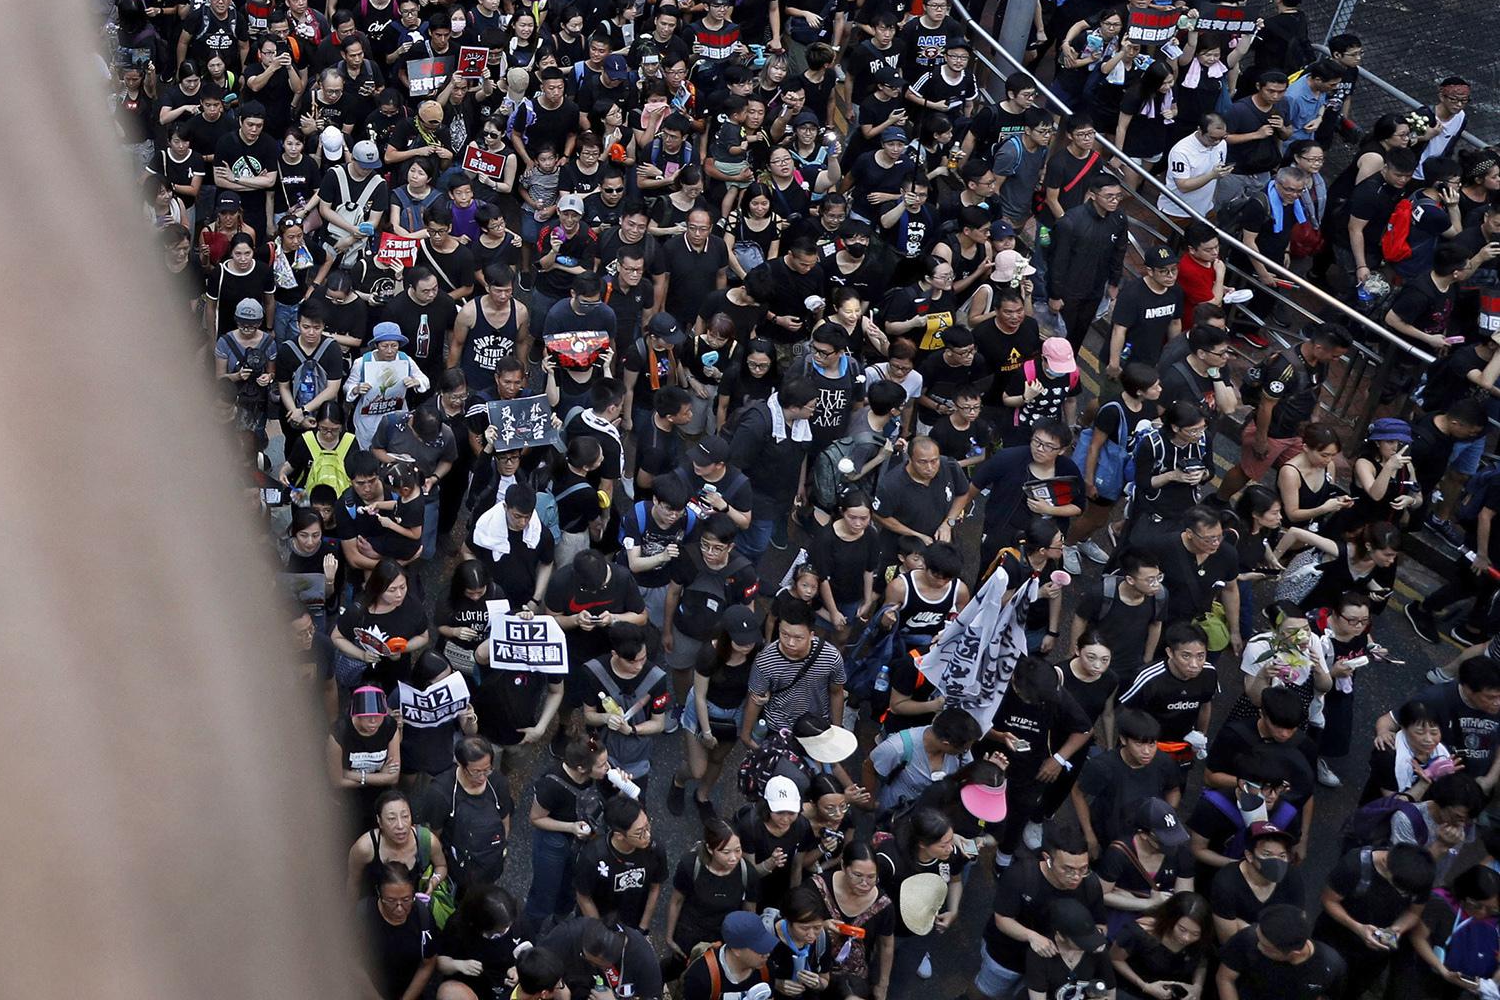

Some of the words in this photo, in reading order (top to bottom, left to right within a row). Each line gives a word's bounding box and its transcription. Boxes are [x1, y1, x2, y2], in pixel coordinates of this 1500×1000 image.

[1195, 18, 1256, 32] 沒有暴動
[917, 36, 947, 47] AAPE
[469, 156, 497, 173] 反送中
[1172, 162, 1184, 173] 10
[484, 348, 505, 357] STATE
[819, 388, 846, 401] THE
[913, 611, 943, 623] NIKE
[508, 623, 546, 640] 612
[495, 644, 562, 665] 不是暴動
[416, 689, 453, 708] 612
[403, 701, 466, 722] 不是暴動
[1167, 701, 1200, 711] adidas
